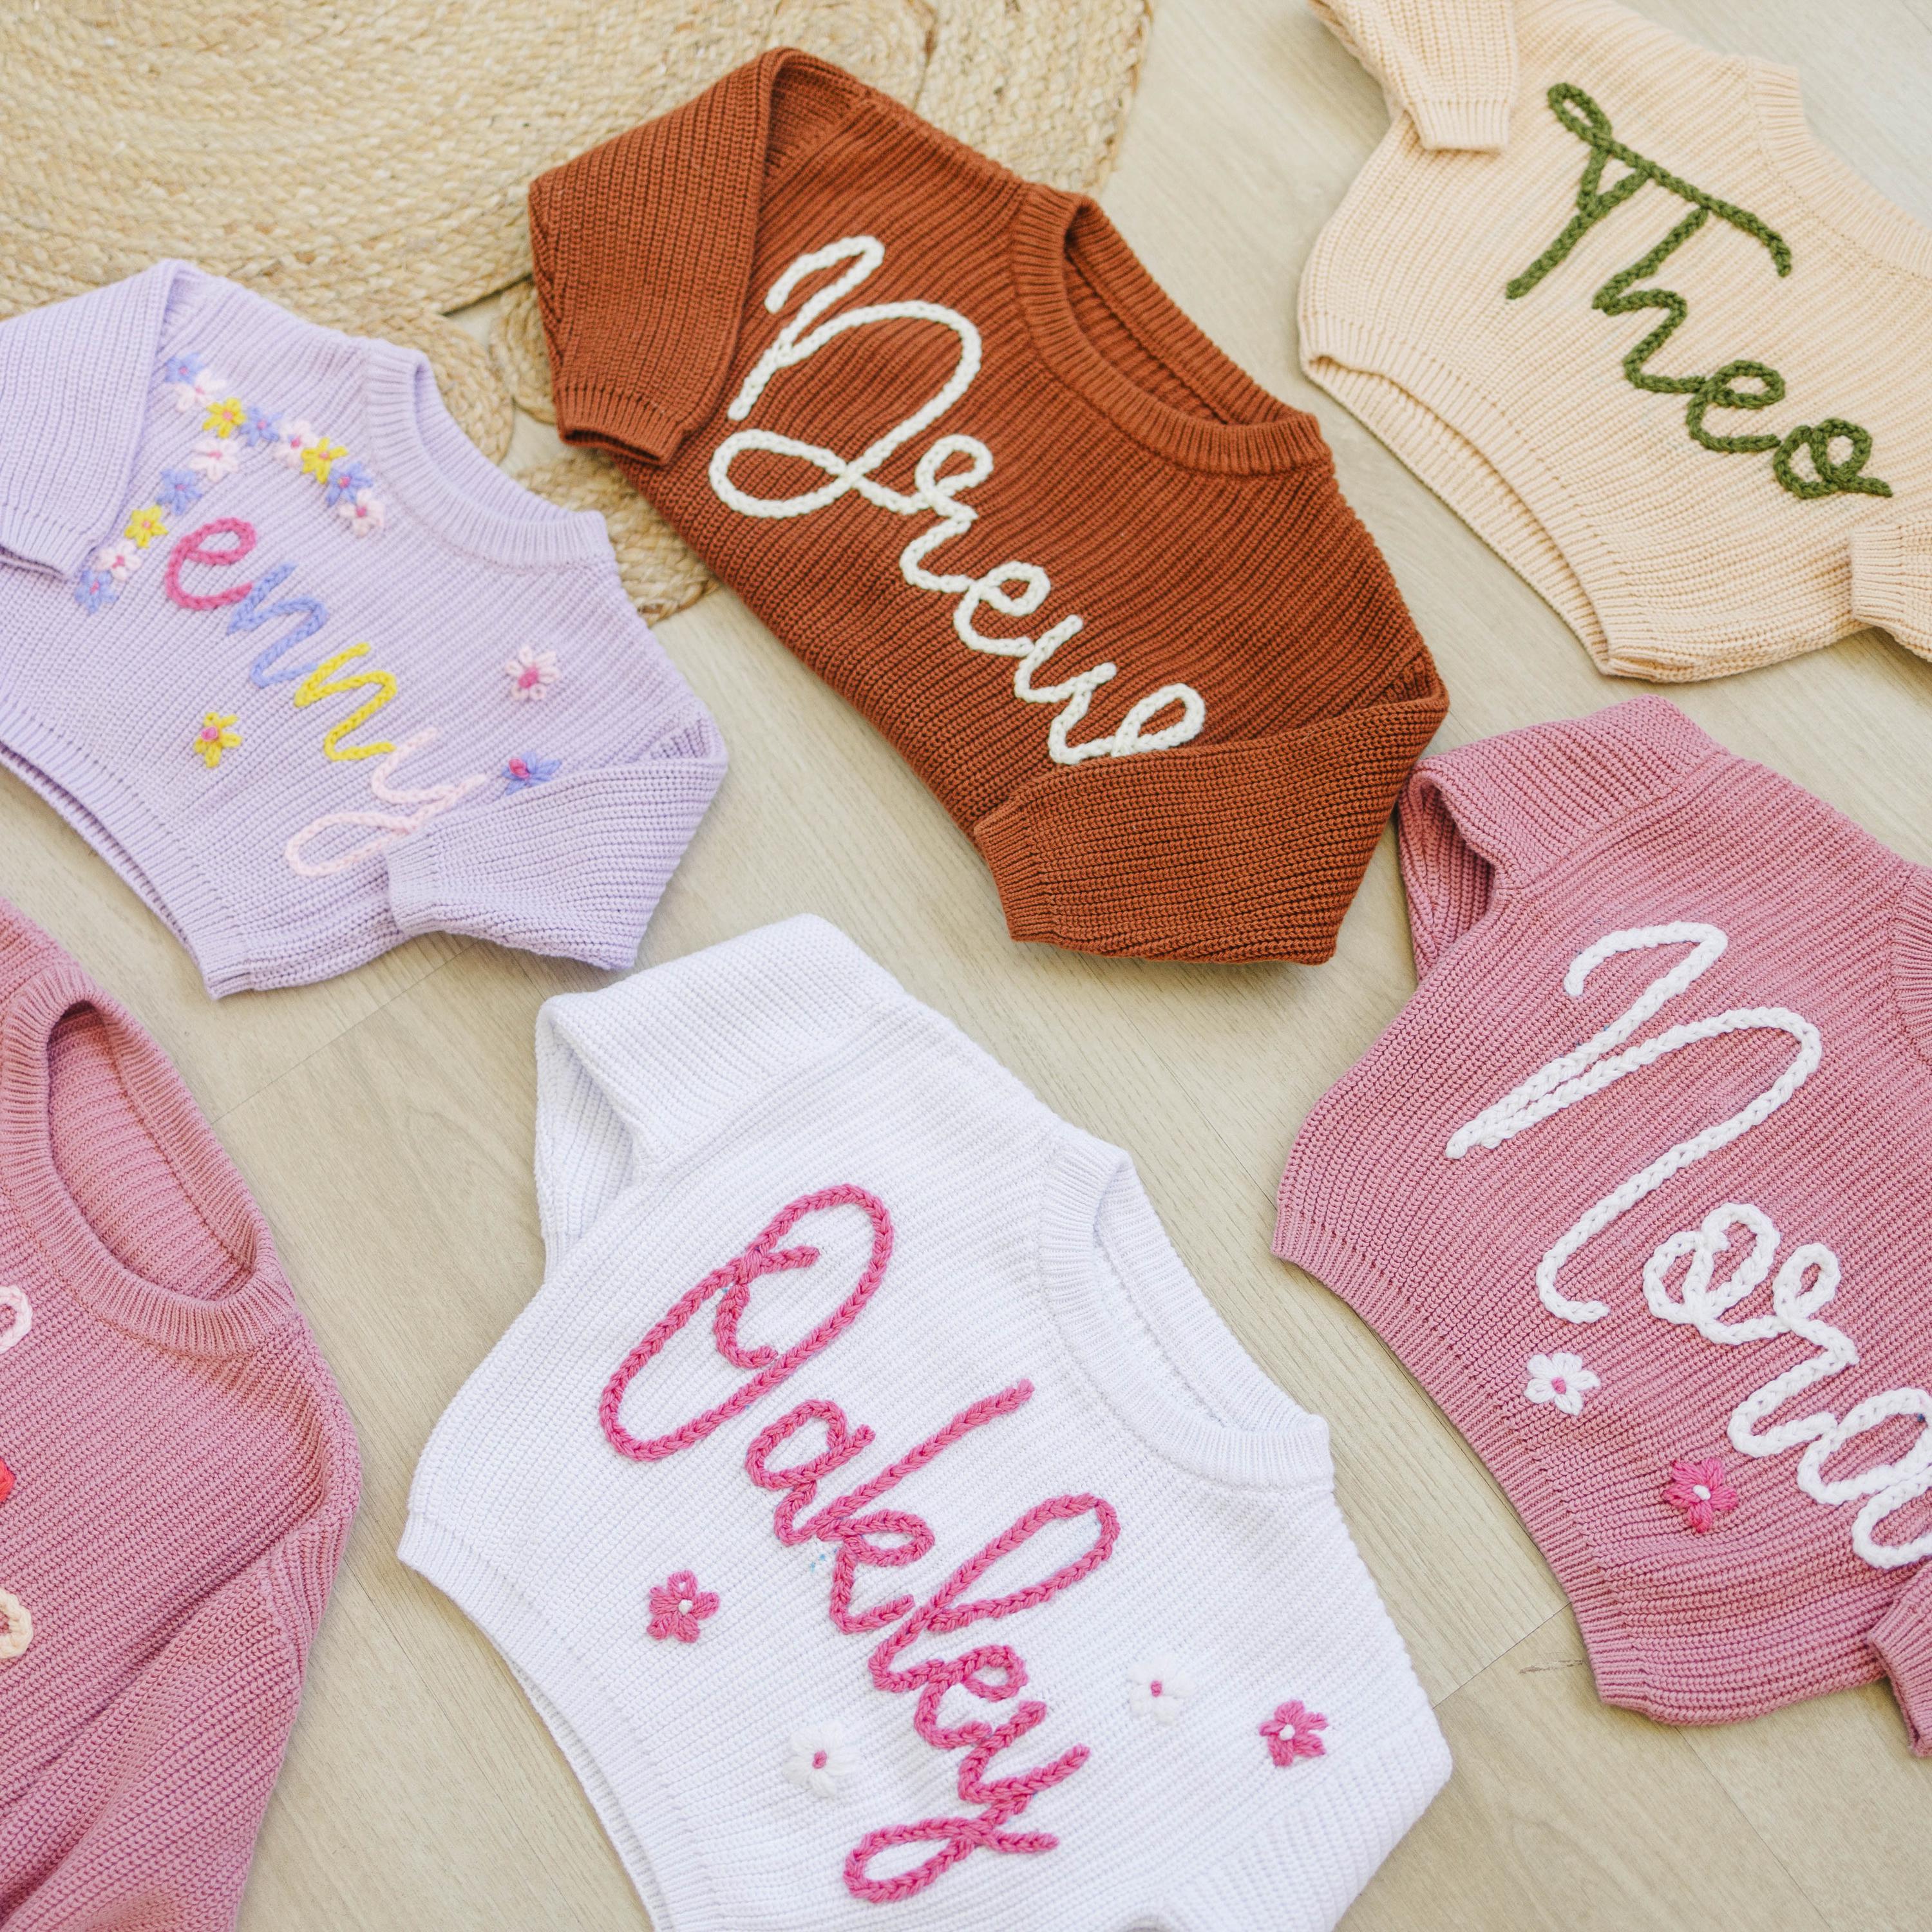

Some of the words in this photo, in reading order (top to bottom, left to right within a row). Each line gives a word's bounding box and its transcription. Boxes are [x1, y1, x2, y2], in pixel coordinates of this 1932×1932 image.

[708, 234, 1206, 765] Drew
[1505, 82, 1893, 500] Theo
[1445, 921, 1932, 1570] Nora
[600, 1183, 1122, 1904] Oakley
